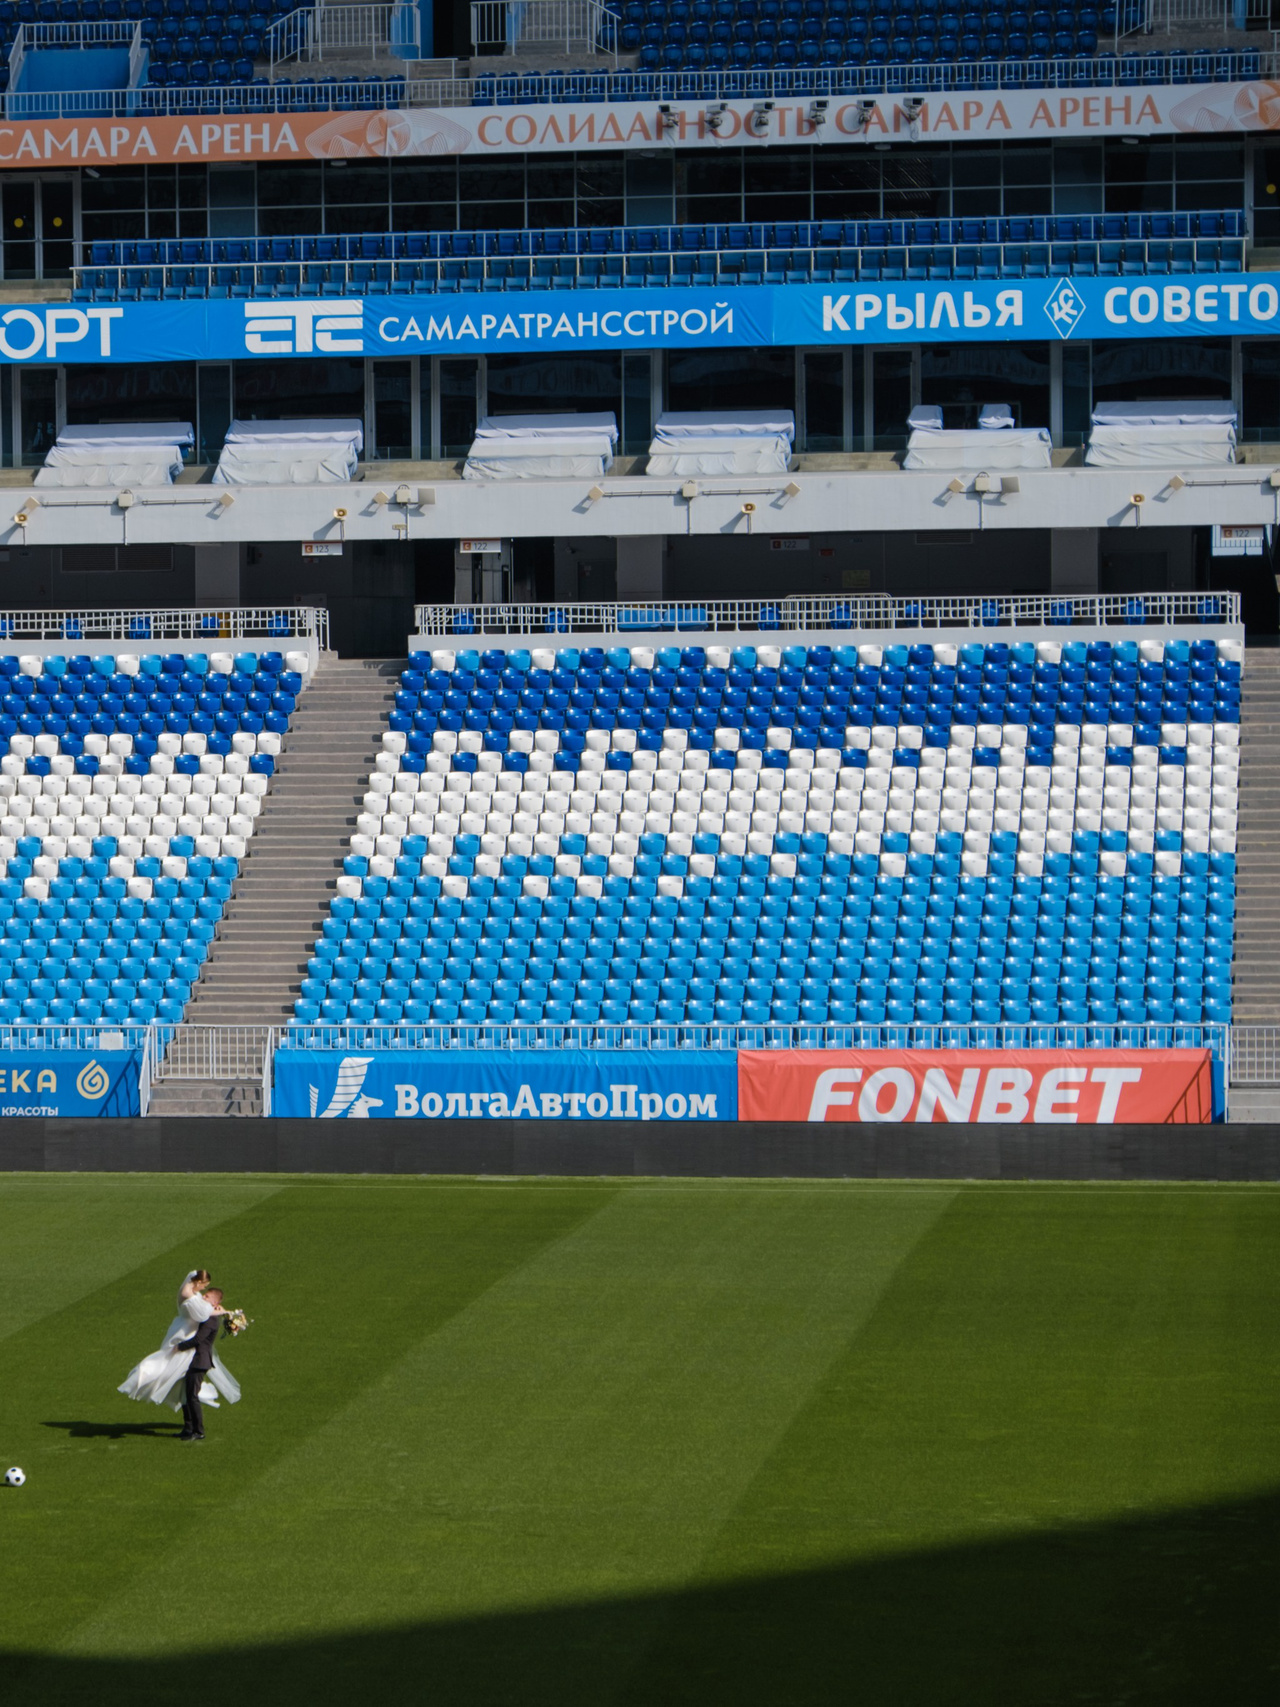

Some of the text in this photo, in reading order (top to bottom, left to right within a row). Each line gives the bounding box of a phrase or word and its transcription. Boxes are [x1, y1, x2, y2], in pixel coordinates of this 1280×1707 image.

[835, 99, 1012, 135] САМАРА
[1029, 94, 1163, 128] АРЕНА
[172, 122, 299, 156] АРЕНА
[378, 302, 734, 342] САМАРАТРАНССТРОЙ
[822, 283, 1279, 331] КРЫЛЬЯ СОВЕТО
[315, 545, 329, 553] 123
[474, 542, 488, 550] 122
[1235, 529, 1249, 537] 122
[1, 1106, 59, 1116] КРАСОТЫ
[394, 1084, 718, 1121] ВолгаАвтоПром
[807, 1067, 1143, 1123] FONBET
